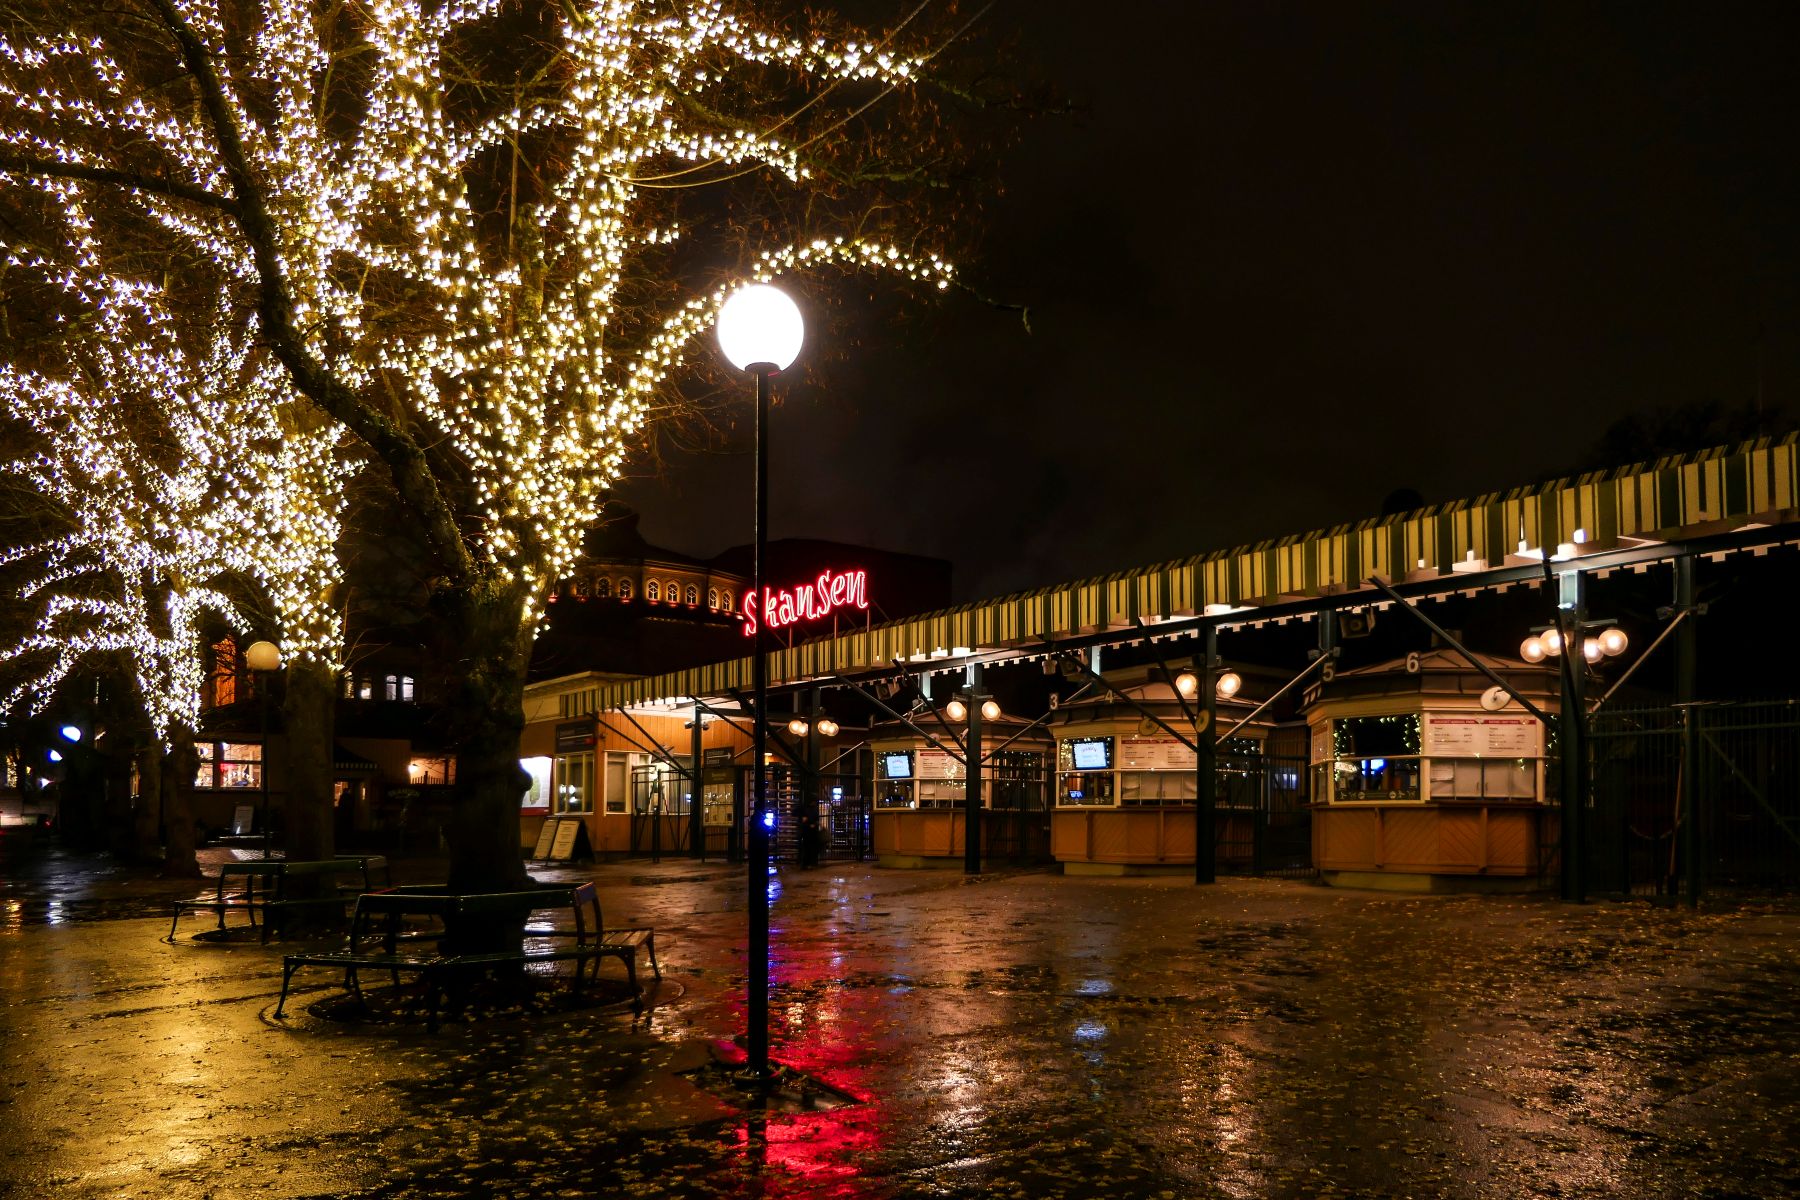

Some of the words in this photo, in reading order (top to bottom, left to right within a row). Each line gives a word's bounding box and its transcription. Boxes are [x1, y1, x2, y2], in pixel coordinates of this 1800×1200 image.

[1406, 651, 1420, 673] 6
[1322, 662, 1334, 682] 5
[1049, 693, 1058, 709] 3
[1105, 688, 1114, 704] 4
